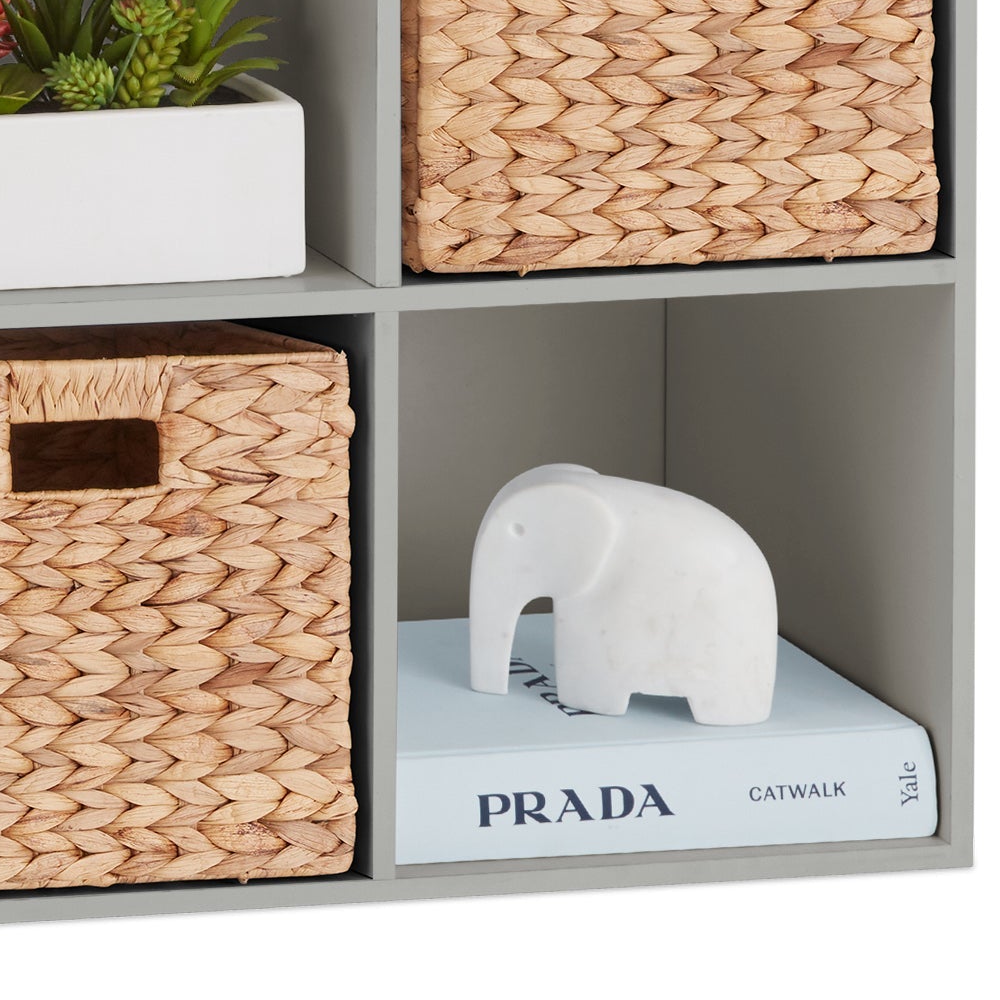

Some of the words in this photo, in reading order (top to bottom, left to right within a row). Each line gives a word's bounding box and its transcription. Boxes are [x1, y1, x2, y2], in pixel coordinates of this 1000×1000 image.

[477, 783, 675, 828] PRADA
[749, 780, 847, 803] CATWALK
[900, 760, 918, 807] Yale
